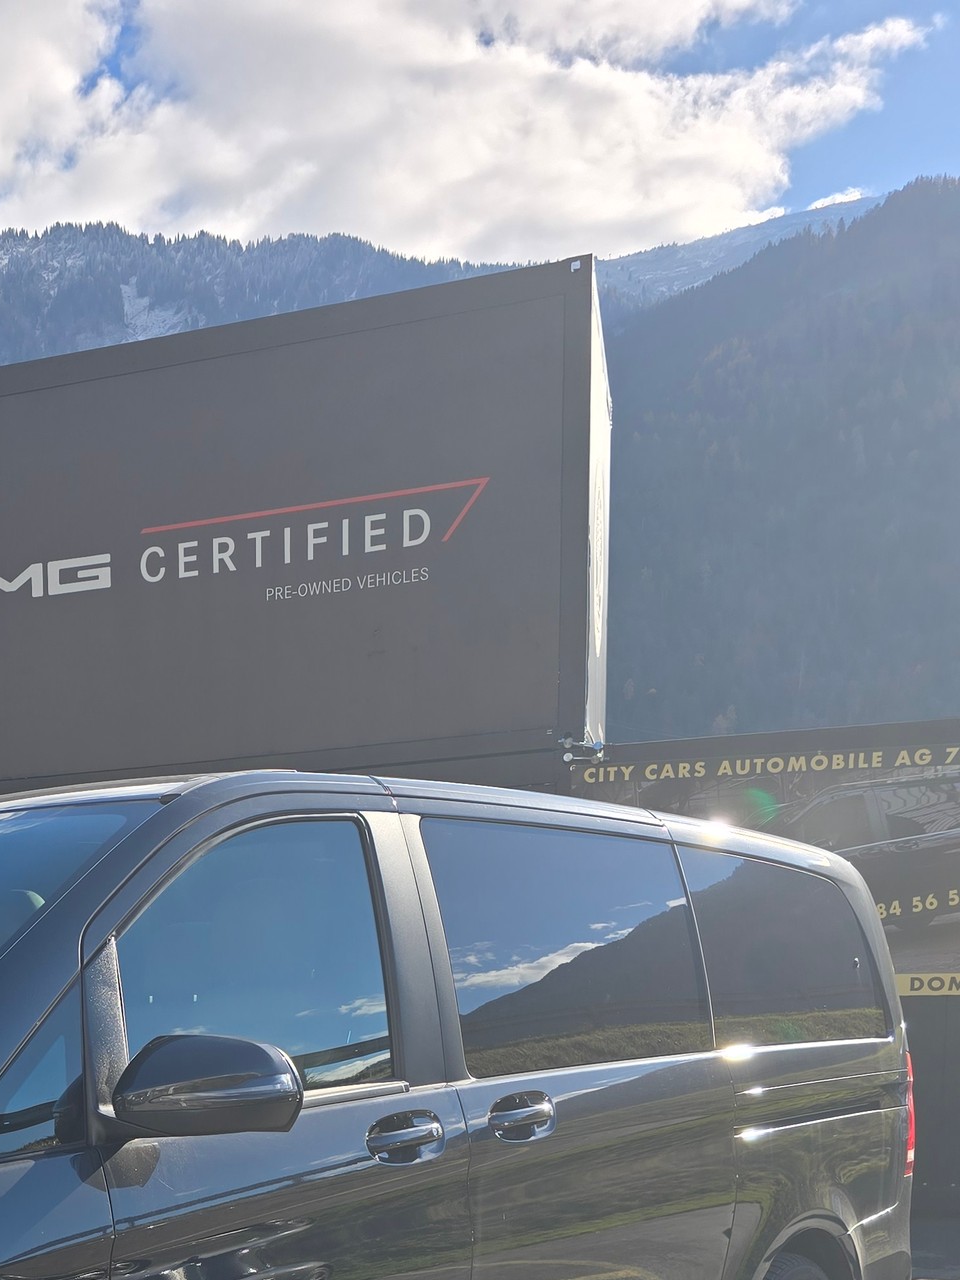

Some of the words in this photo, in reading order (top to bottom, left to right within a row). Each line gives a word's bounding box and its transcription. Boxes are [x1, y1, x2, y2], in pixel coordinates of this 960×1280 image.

[140, 508, 431, 583] CERTIFIED
[266, 578, 352, 601] PRE-OWNED
[356, 567, 430, 590] VEHICLES
[583, 765, 635, 784] CITY
[644, 761, 706, 780] CARS
[717, 751, 883, 776] AUTOMOBILE
[894, 748, 933, 766] AG
[912, 893, 939, 913] 56
[948, 889, 960, 906] 5
